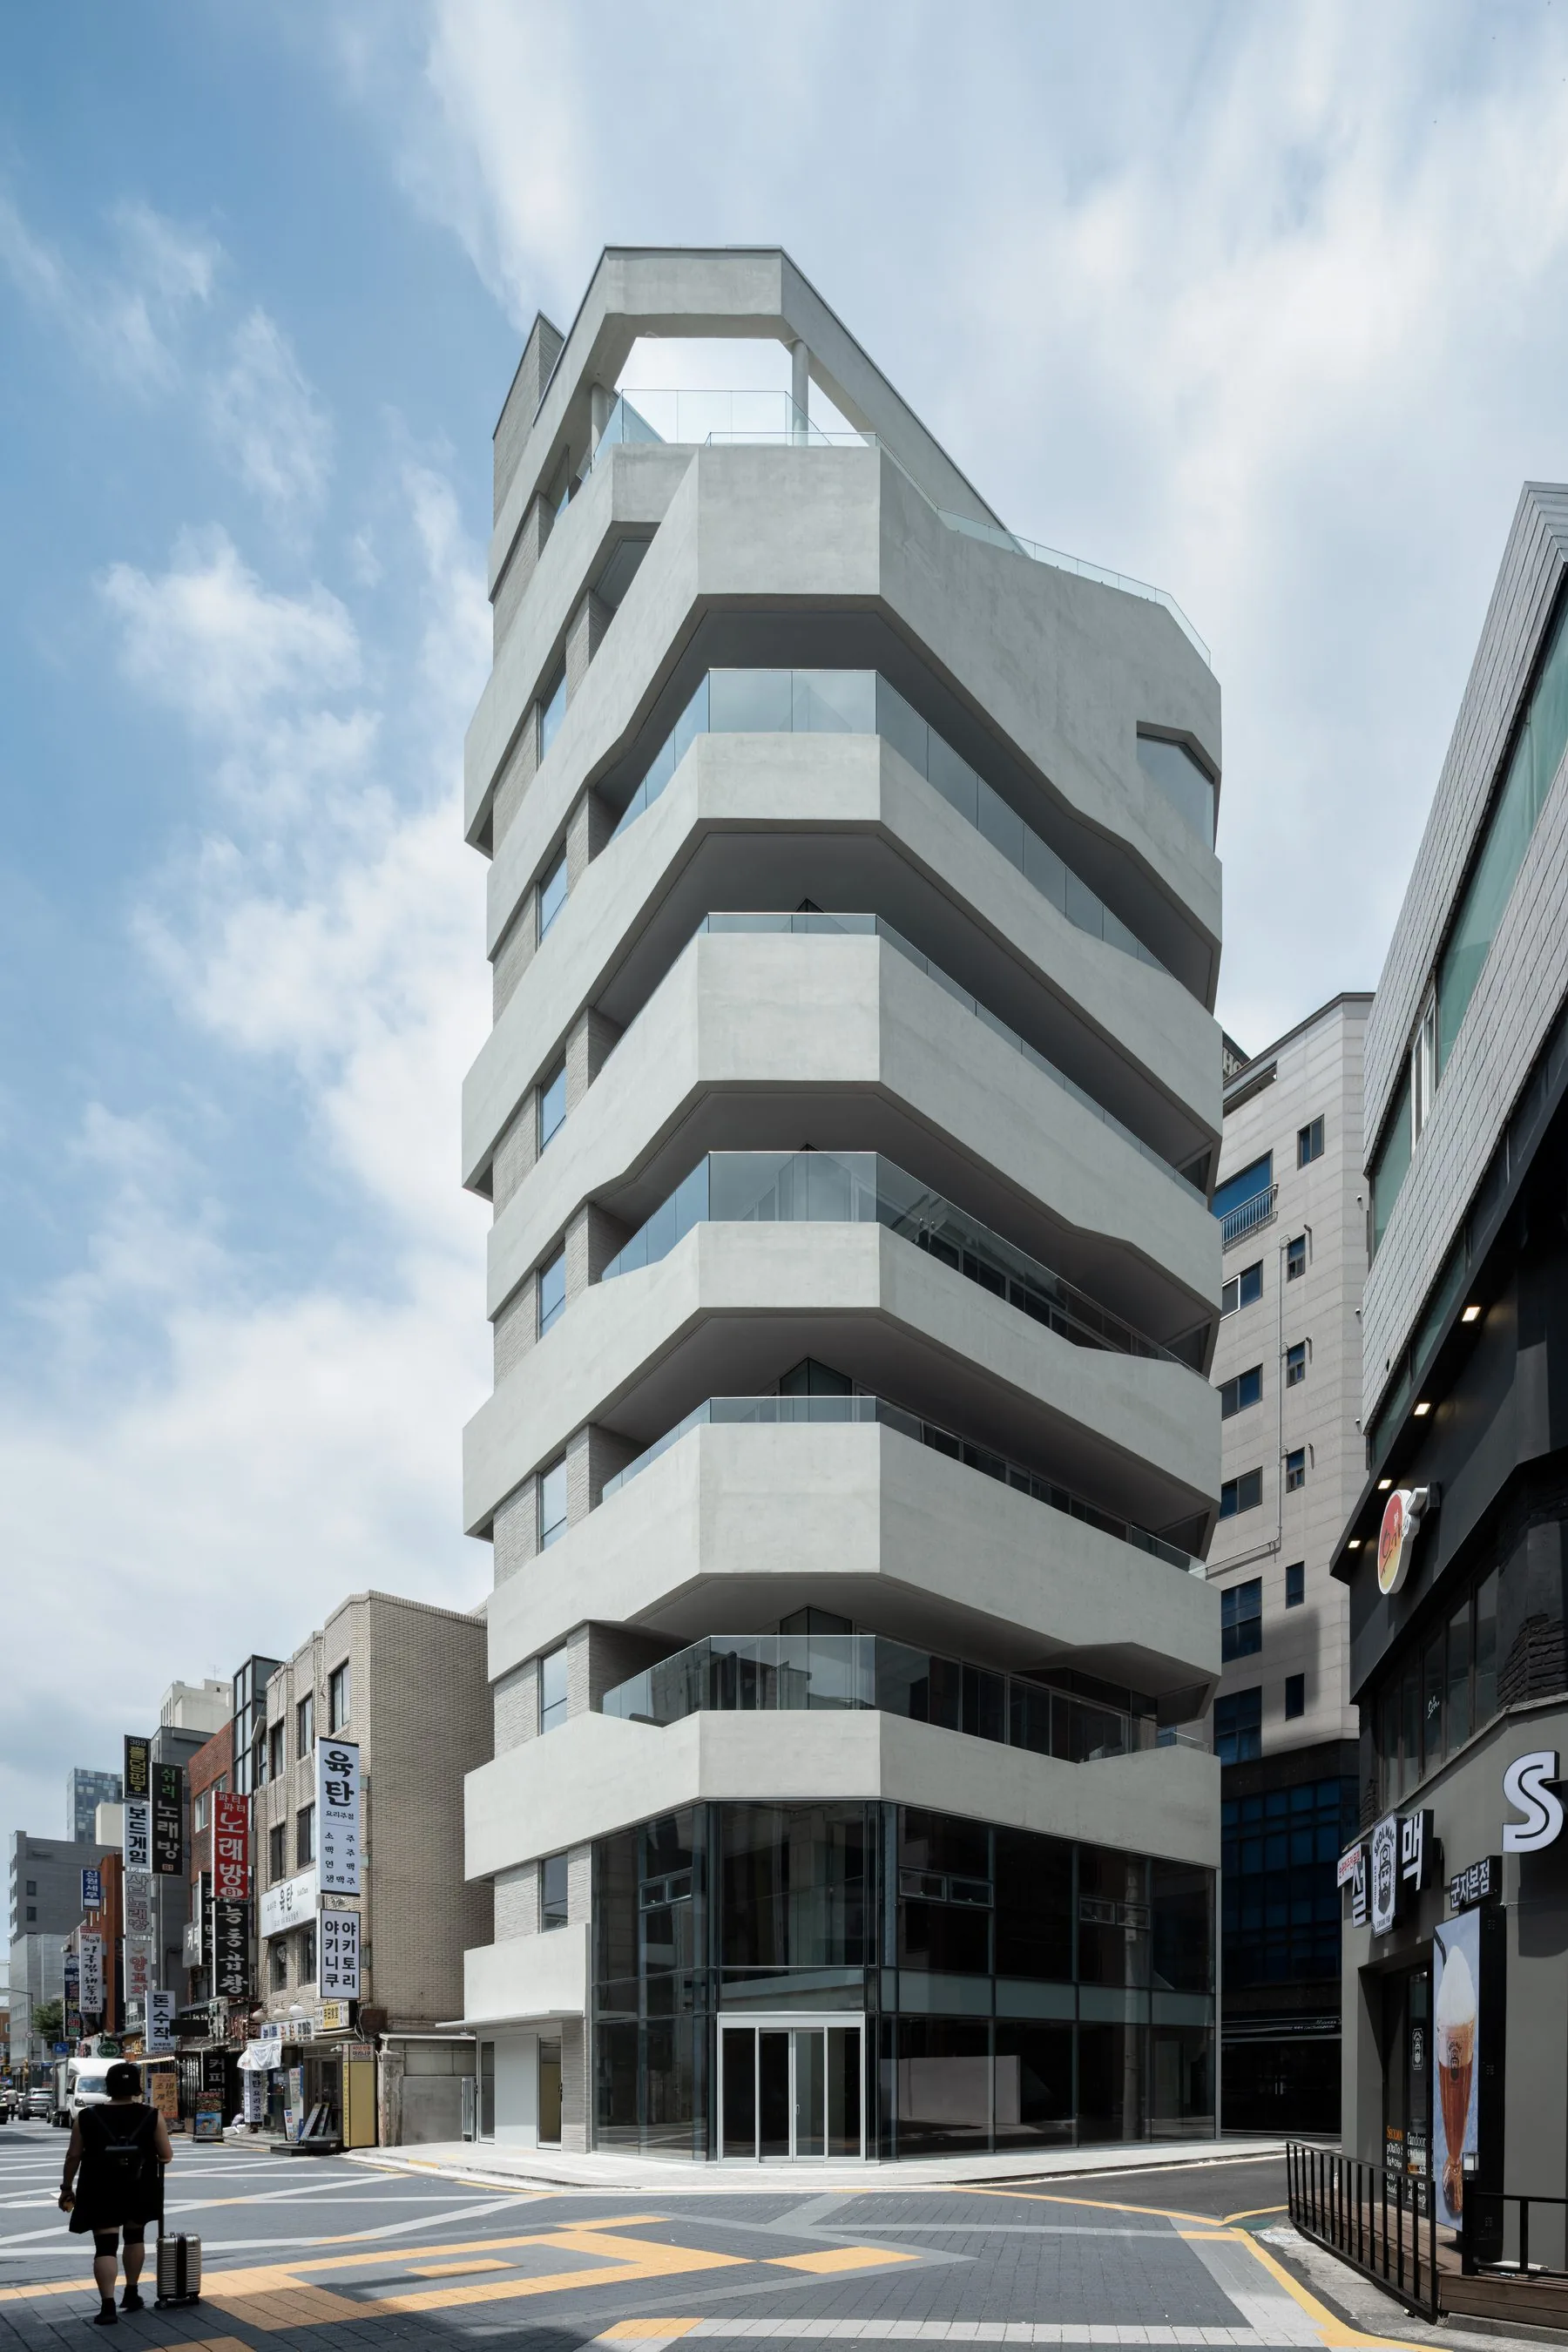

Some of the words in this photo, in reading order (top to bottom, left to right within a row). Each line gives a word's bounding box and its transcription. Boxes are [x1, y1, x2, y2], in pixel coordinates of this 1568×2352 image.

[324, 1750, 354, 1807] 육탄
[1502, 1750, 1564, 1853] S
[129, 1806, 147, 1864] 보드게임
[157, 1800, 180, 1860] 노래방
[325, 1810, 355, 1821] 요리주점
[218, 1813, 246, 1886] 노래방
[226, 1888, 240, 1896] B1
[1450, 1858, 1490, 1911] 군자본점
[218, 1904, 248, 1995] 능동곱창
[325, 1920, 339, 1989] 야키니쿠
[341, 1920, 356, 1990] 야키토리
[152, 1994, 171, 2040] 돈수작
